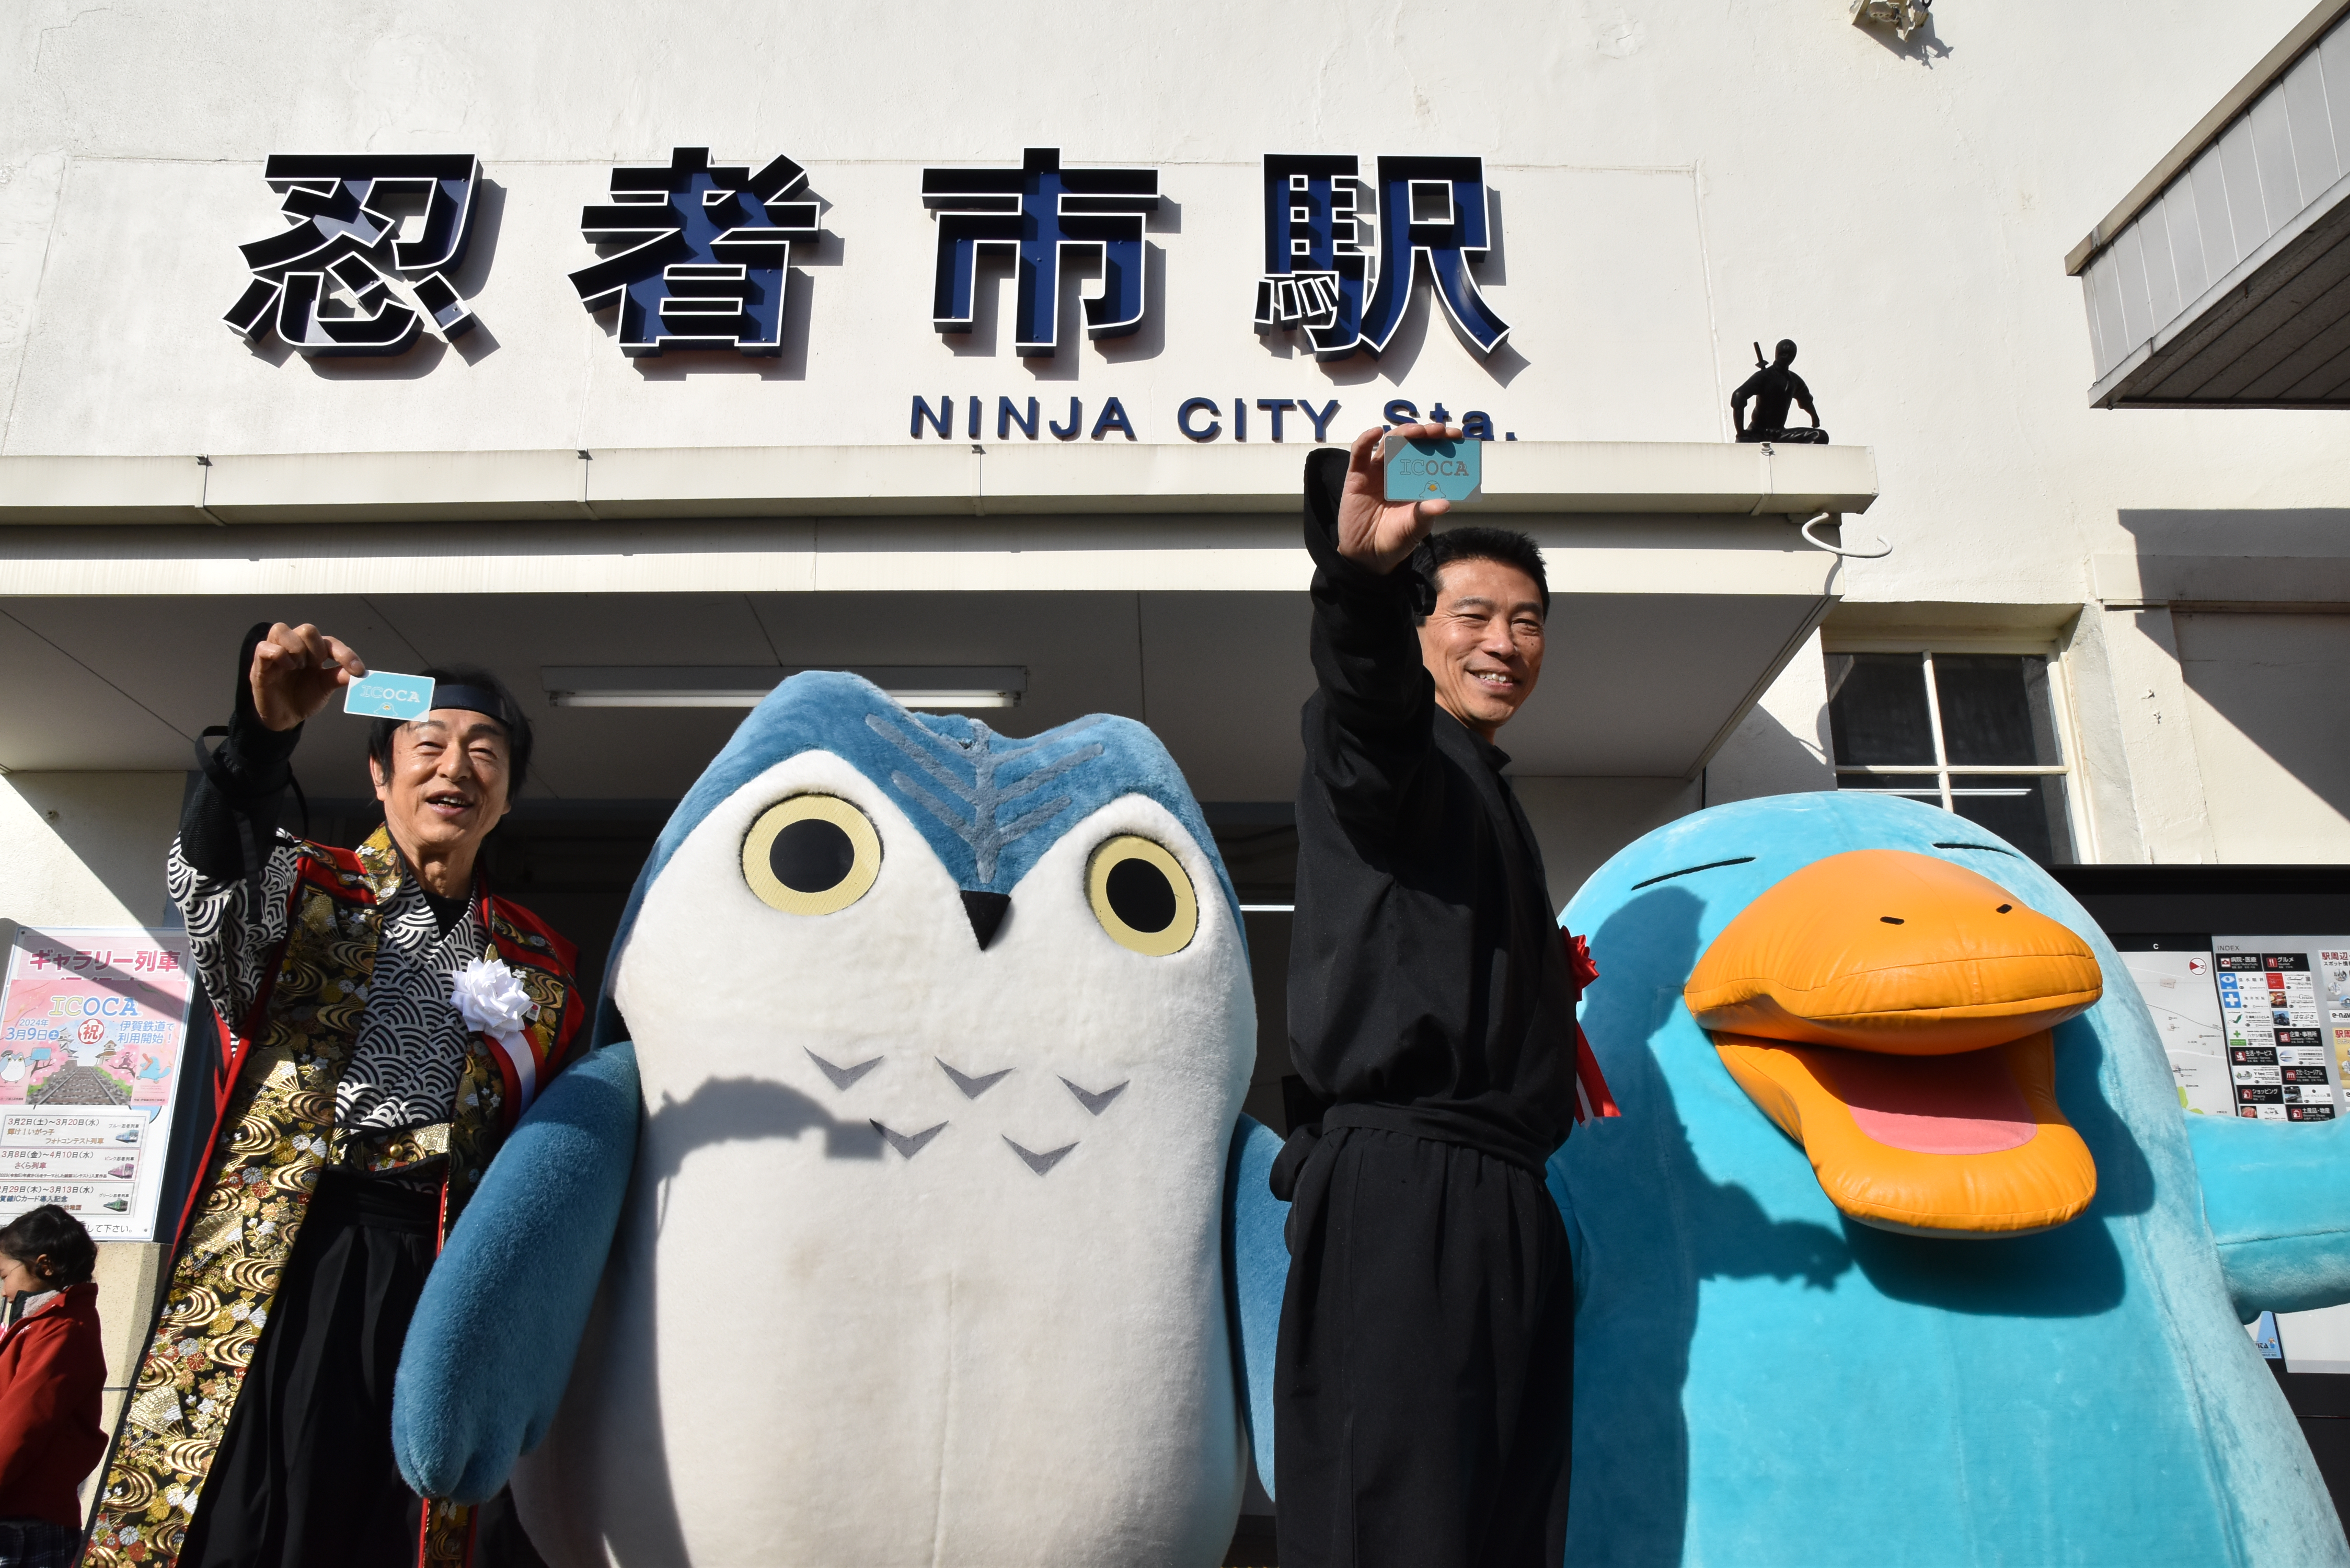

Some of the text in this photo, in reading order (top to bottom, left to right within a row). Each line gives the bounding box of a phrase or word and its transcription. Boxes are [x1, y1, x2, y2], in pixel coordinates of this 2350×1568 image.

[222, 147, 1511, 361] 忍者市駅
[910, 395, 1137, 441] NINJA
[1177, 397, 1340, 443] CITY
[1400, 459, 1469, 476] ICOCA
[360, 685, 421, 703] ICOCA
[30, 949, 181, 972] ギャラリー列車
[2321, 952, 2350, 960] 駅周辺
[49, 997, 139, 1016] ICOCA
[83, 1024, 98, 1040] 祝
[120, 1021, 175, 1031] 伊賀鉄道で
[118, 1033, 171, 1044] 利用開始！
